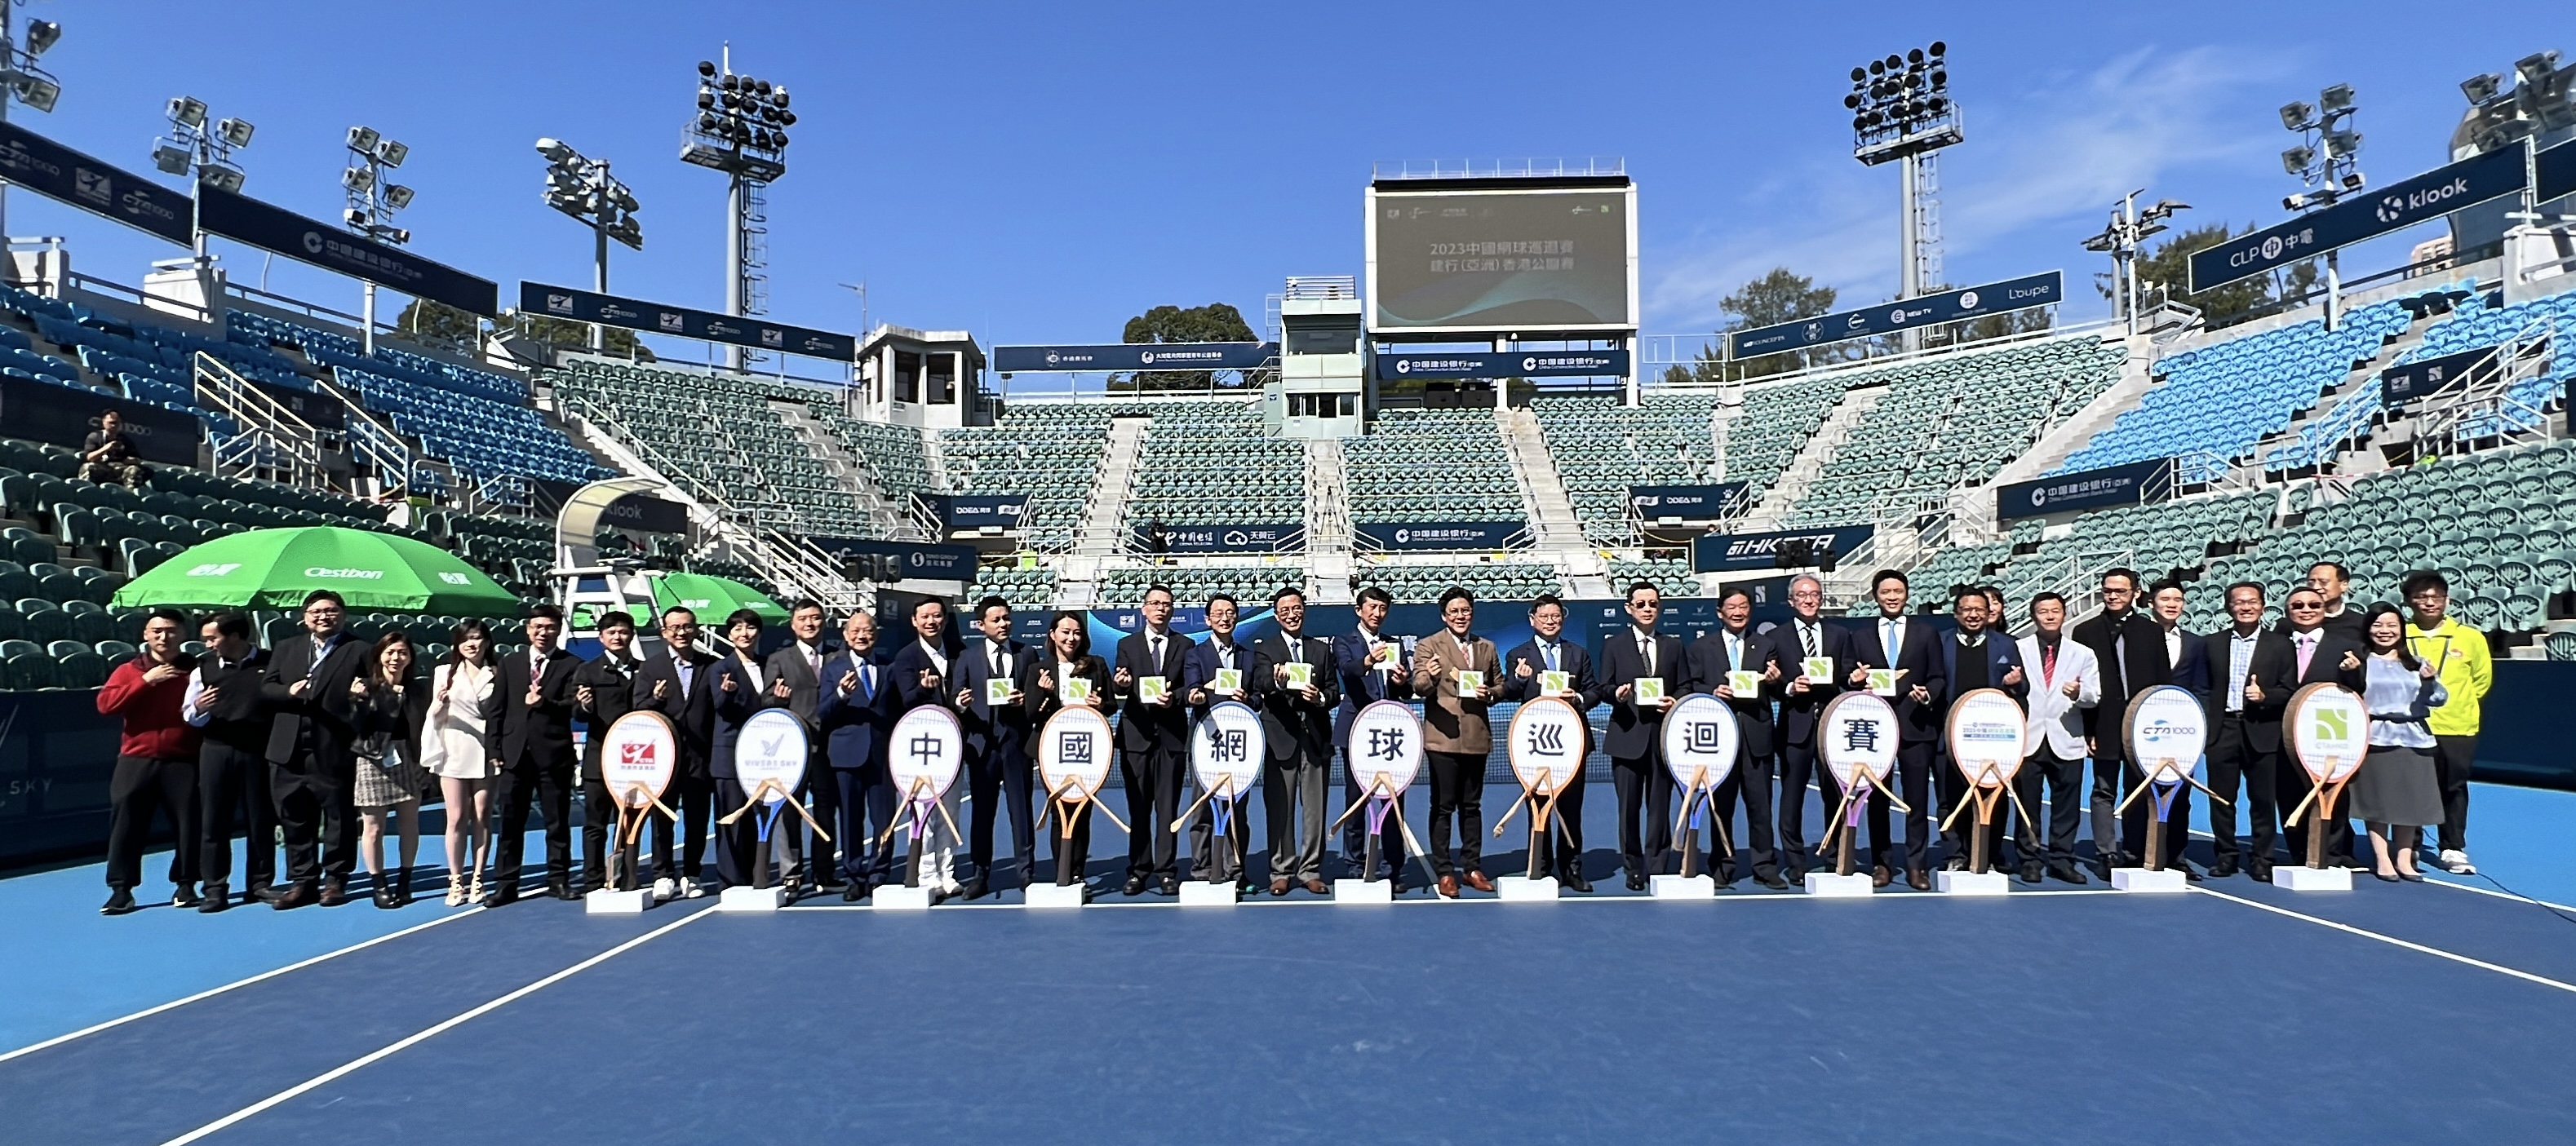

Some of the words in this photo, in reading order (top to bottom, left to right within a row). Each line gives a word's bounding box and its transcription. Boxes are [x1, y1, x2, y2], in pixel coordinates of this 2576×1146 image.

[2409, 177, 2468, 210] klook
[2285, 228, 2314, 250] 中電
[2230, 249, 2259, 268] CLP
[911, 732, 941, 765] 中
[1060, 731, 1093, 764] 國
[1211, 729, 1247, 762] 網
[1368, 728, 1404, 761] 球
[1528, 723, 1565, 756] 巡
[1684, 721, 1719, 754] 迴
[1843, 719, 1880, 752] 賽
[9, 778, 54, 795] SKY
